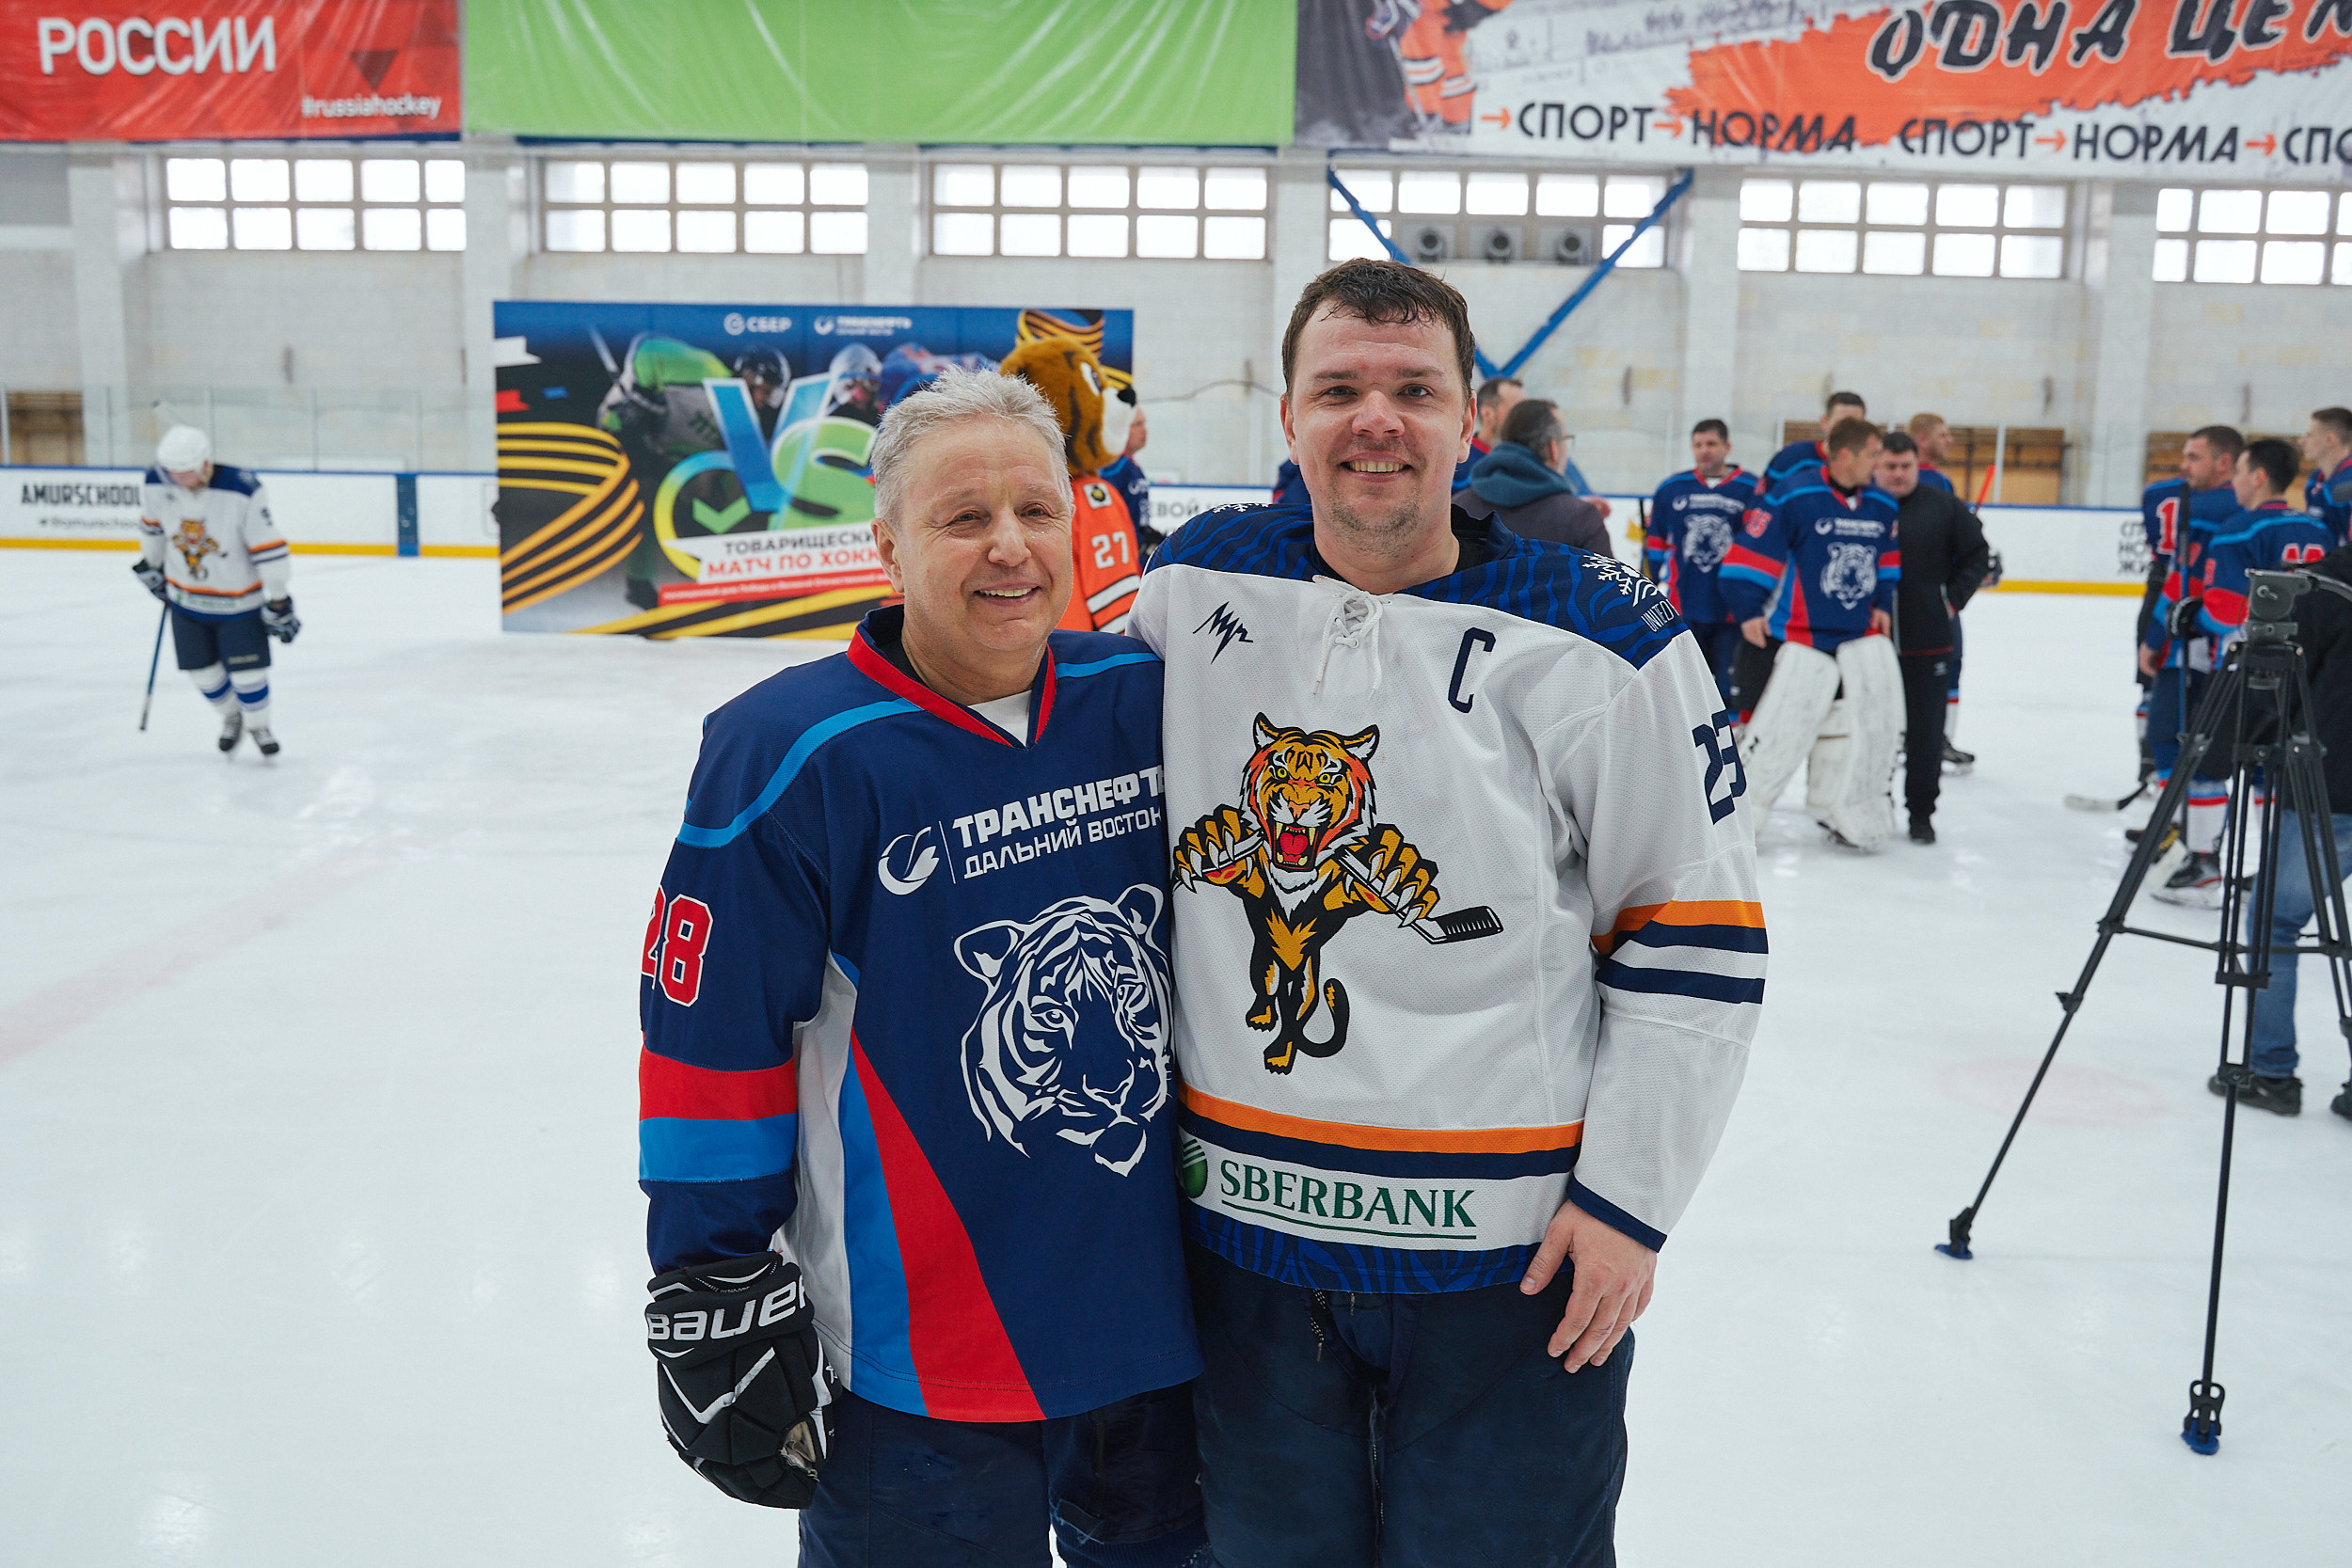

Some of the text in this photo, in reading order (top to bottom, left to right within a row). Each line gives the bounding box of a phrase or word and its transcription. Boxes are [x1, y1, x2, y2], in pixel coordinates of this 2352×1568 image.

[38, 16, 276, 75] РОССИИ
[1868, 0, 2137, 79] ОДНА
[301, 93, 441, 120] #russiahockey
[1518, 103, 1654, 144] СПОРТ
[1692, 109, 1857, 152] НОРМА
[1899, 118, 2034, 158] СПОРТ
[2074, 123, 2239, 162] НОРМА
[707, 553, 771, 577] МАТЧ
[779, 545, 812, 570] ПО
[1091, 531, 1129, 570] 27
[1641, 600, 1675, 632] UNITED
[1448, 626, 1496, 714] C
[1692, 708, 1747, 826] 23
[963, 806, 1162, 879] ДАЛЬНИЙ ВОСТОК
[641, 883, 714, 1007] 28
[1220, 1159, 1477, 1227] SBERBANK
